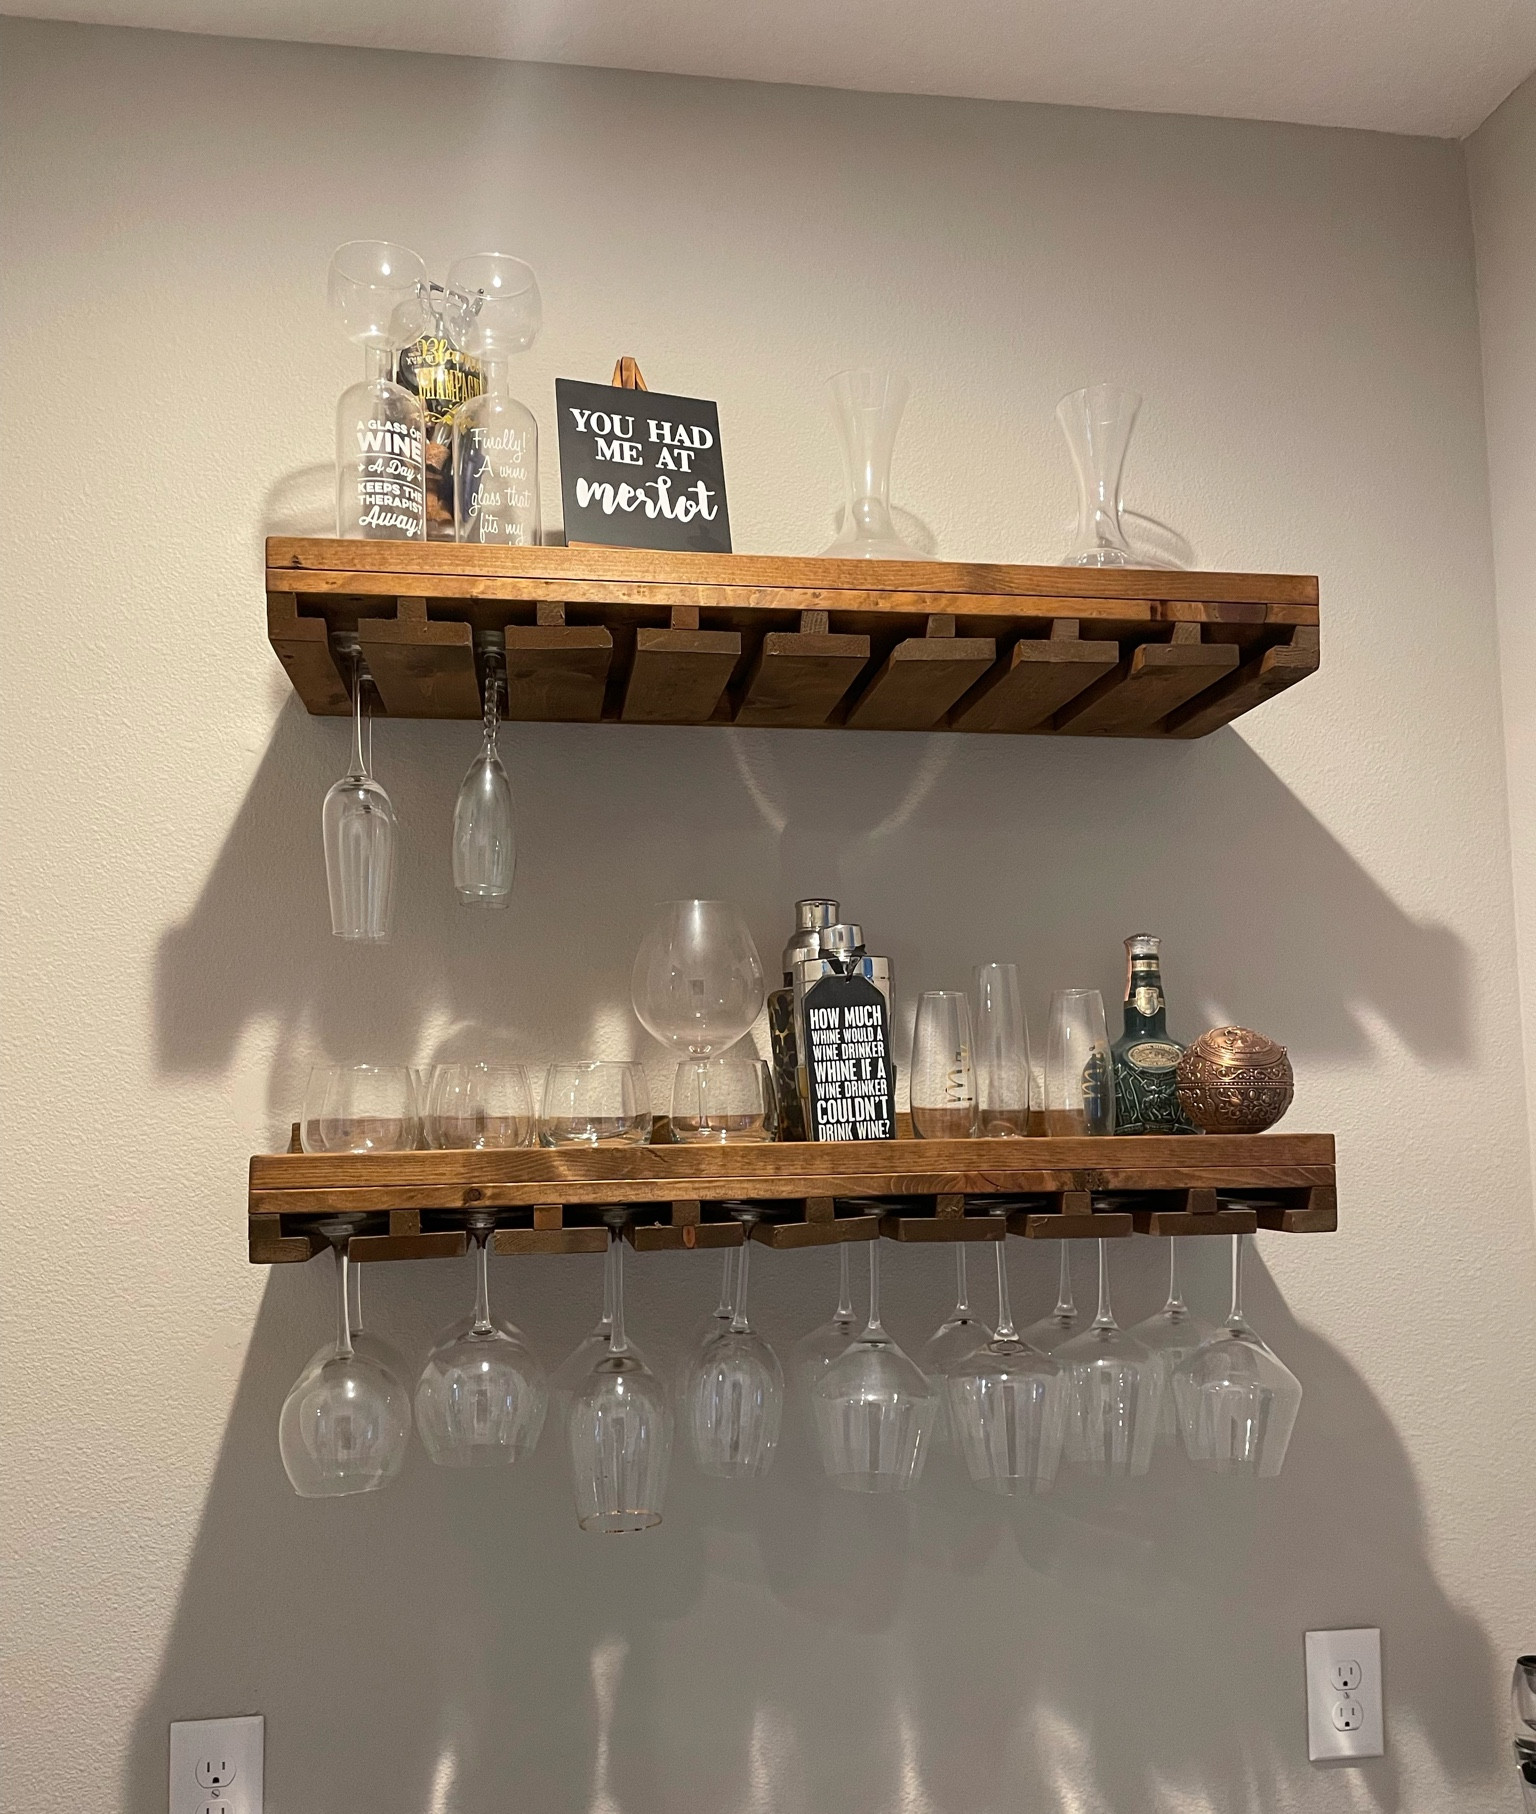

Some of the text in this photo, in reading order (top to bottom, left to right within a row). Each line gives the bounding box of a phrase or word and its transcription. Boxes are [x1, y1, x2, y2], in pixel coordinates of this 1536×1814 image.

[356, 420, 422, 442] A GLASS OF
[569, 407, 714, 449] YOU HAD
[357, 431, 422, 464] WINE
[470, 427, 527, 463] Finally!
[594, 437, 695, 473] ME AT
[367, 458, 416, 481] A Day
[473, 454, 528, 480] A wine
[357, 494, 423, 515] THERAPIST
[358, 481, 423, 504] KEEPS THE
[468, 483, 532, 517] glass that
[576, 475, 719, 523] merlot
[359, 505, 423, 537] Away!
[479, 512, 525, 547] fits my
[809, 1004, 882, 1030] HOW MUCH
[811, 1025, 884, 1045] WHINE WOULD A
[812, 1041, 885, 1061] WINE DRINKER
[813, 1057, 887, 1083] WHINE IF A
[815, 1079, 888, 1100] WINE DRINKER
[816, 1095, 889, 1124] COULDN'T
[818, 1119, 890, 1142] DRINK WINE?
